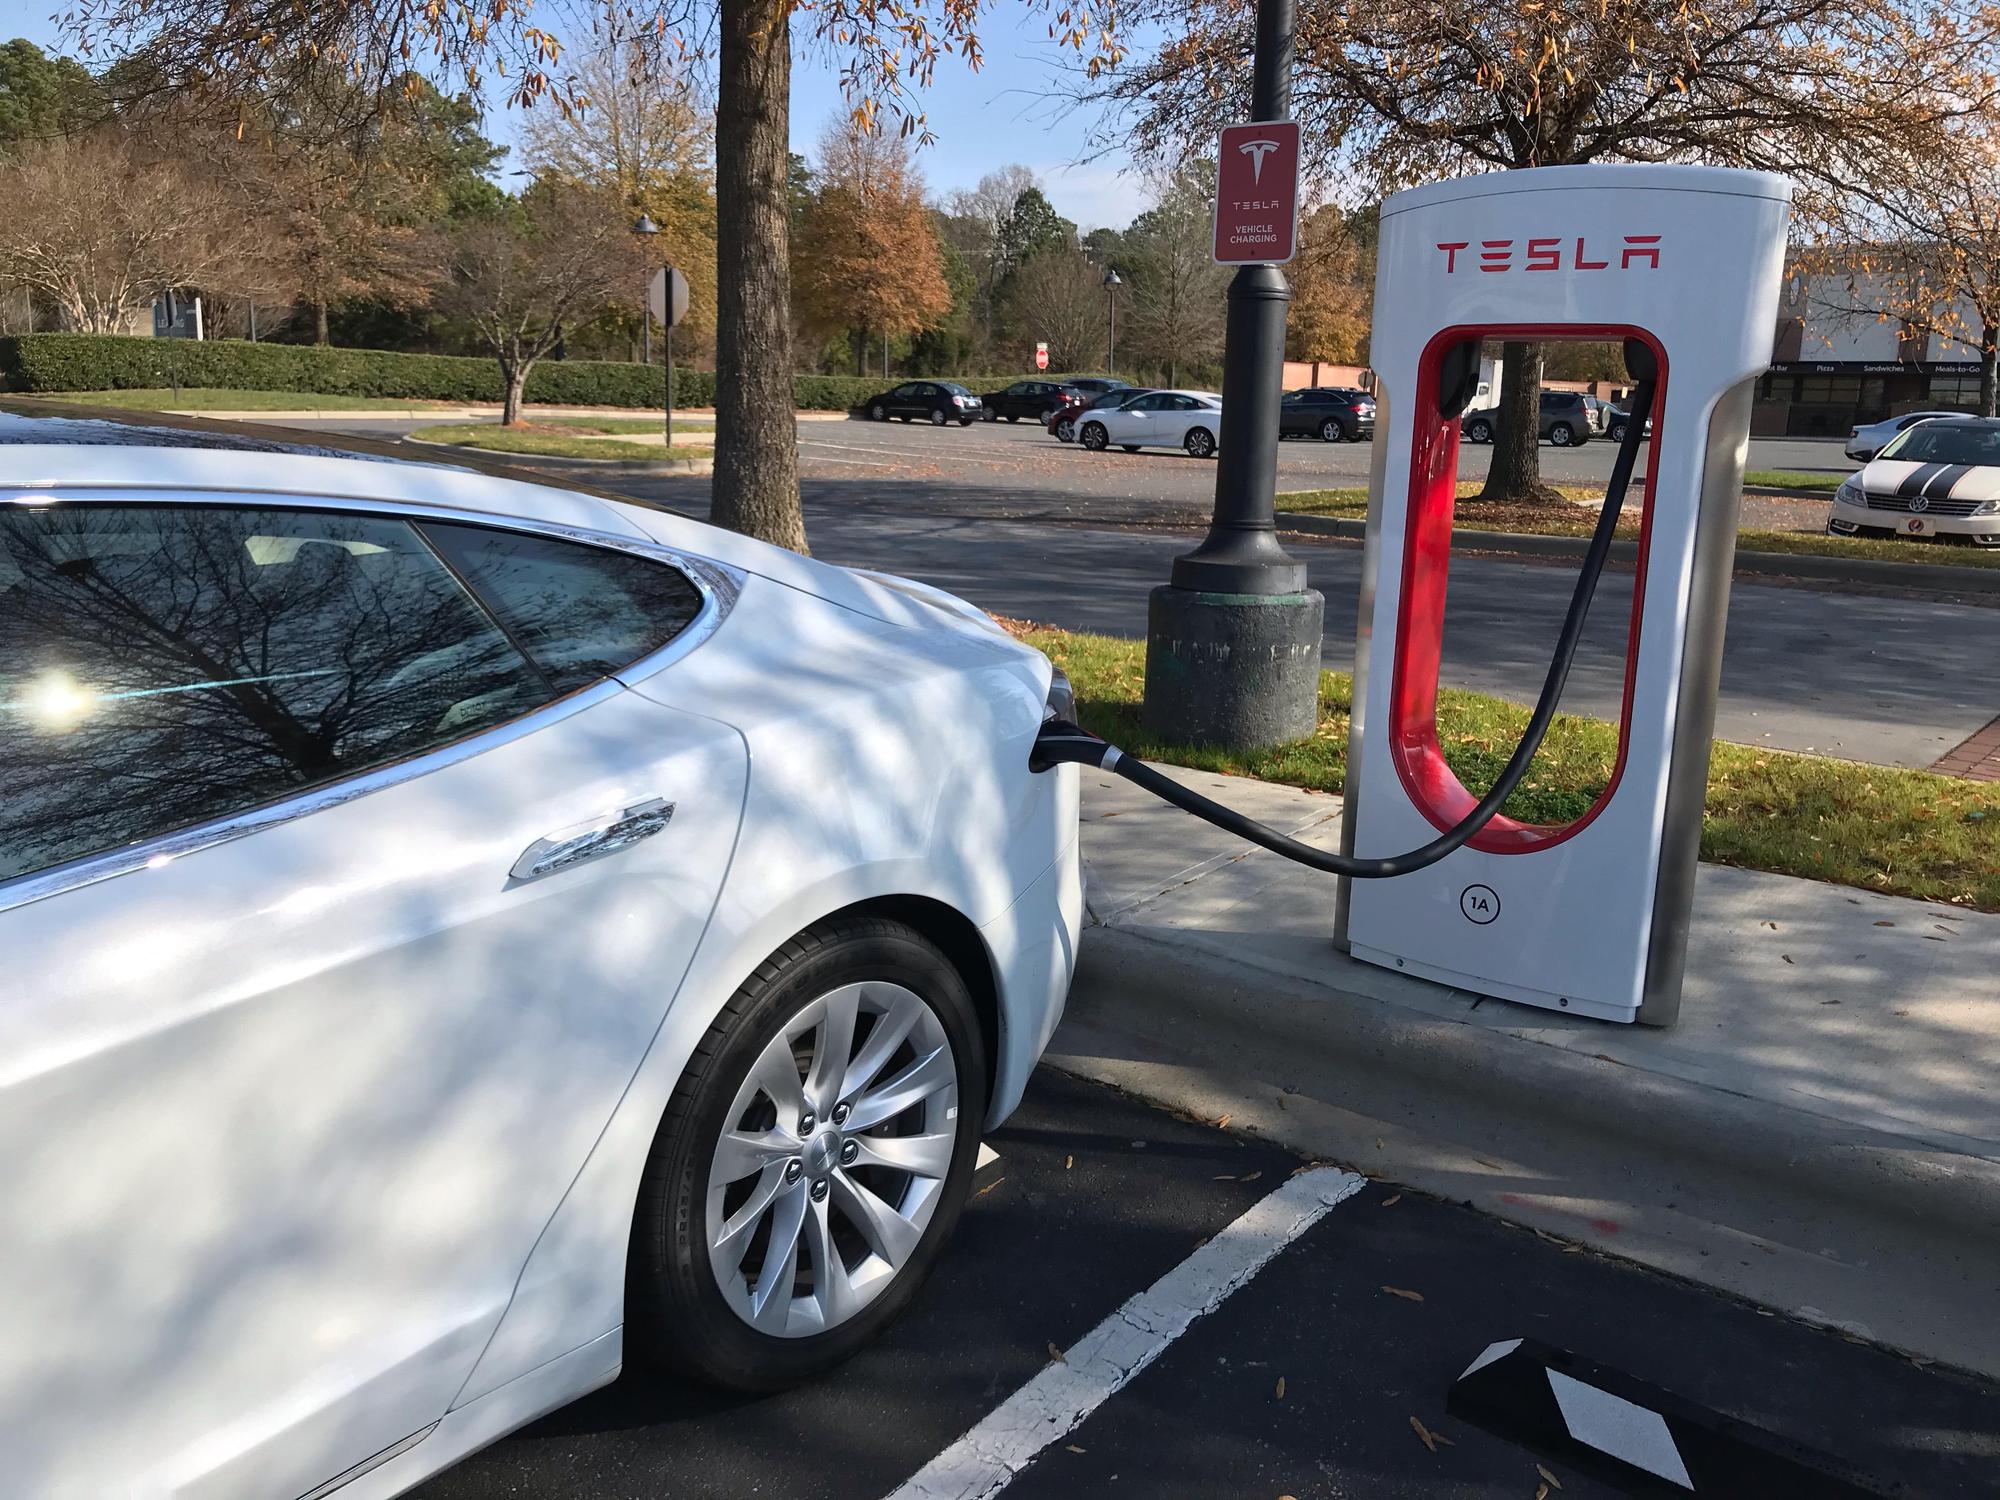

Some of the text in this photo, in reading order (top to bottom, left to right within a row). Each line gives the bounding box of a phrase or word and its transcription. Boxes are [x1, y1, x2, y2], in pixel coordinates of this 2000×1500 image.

[1233, 200, 1279, 210] TESLA
[1235, 225, 1273, 234] VEHICLE
[1230, 234, 1277, 244] CHARGING
[1436, 235, 1662, 274] TESLA
[1816, 364, 1835, 372] Pizza
[1935, 365, 1981, 373] Meals-to-Go
[1471, 897, 1489, 912] 1A
